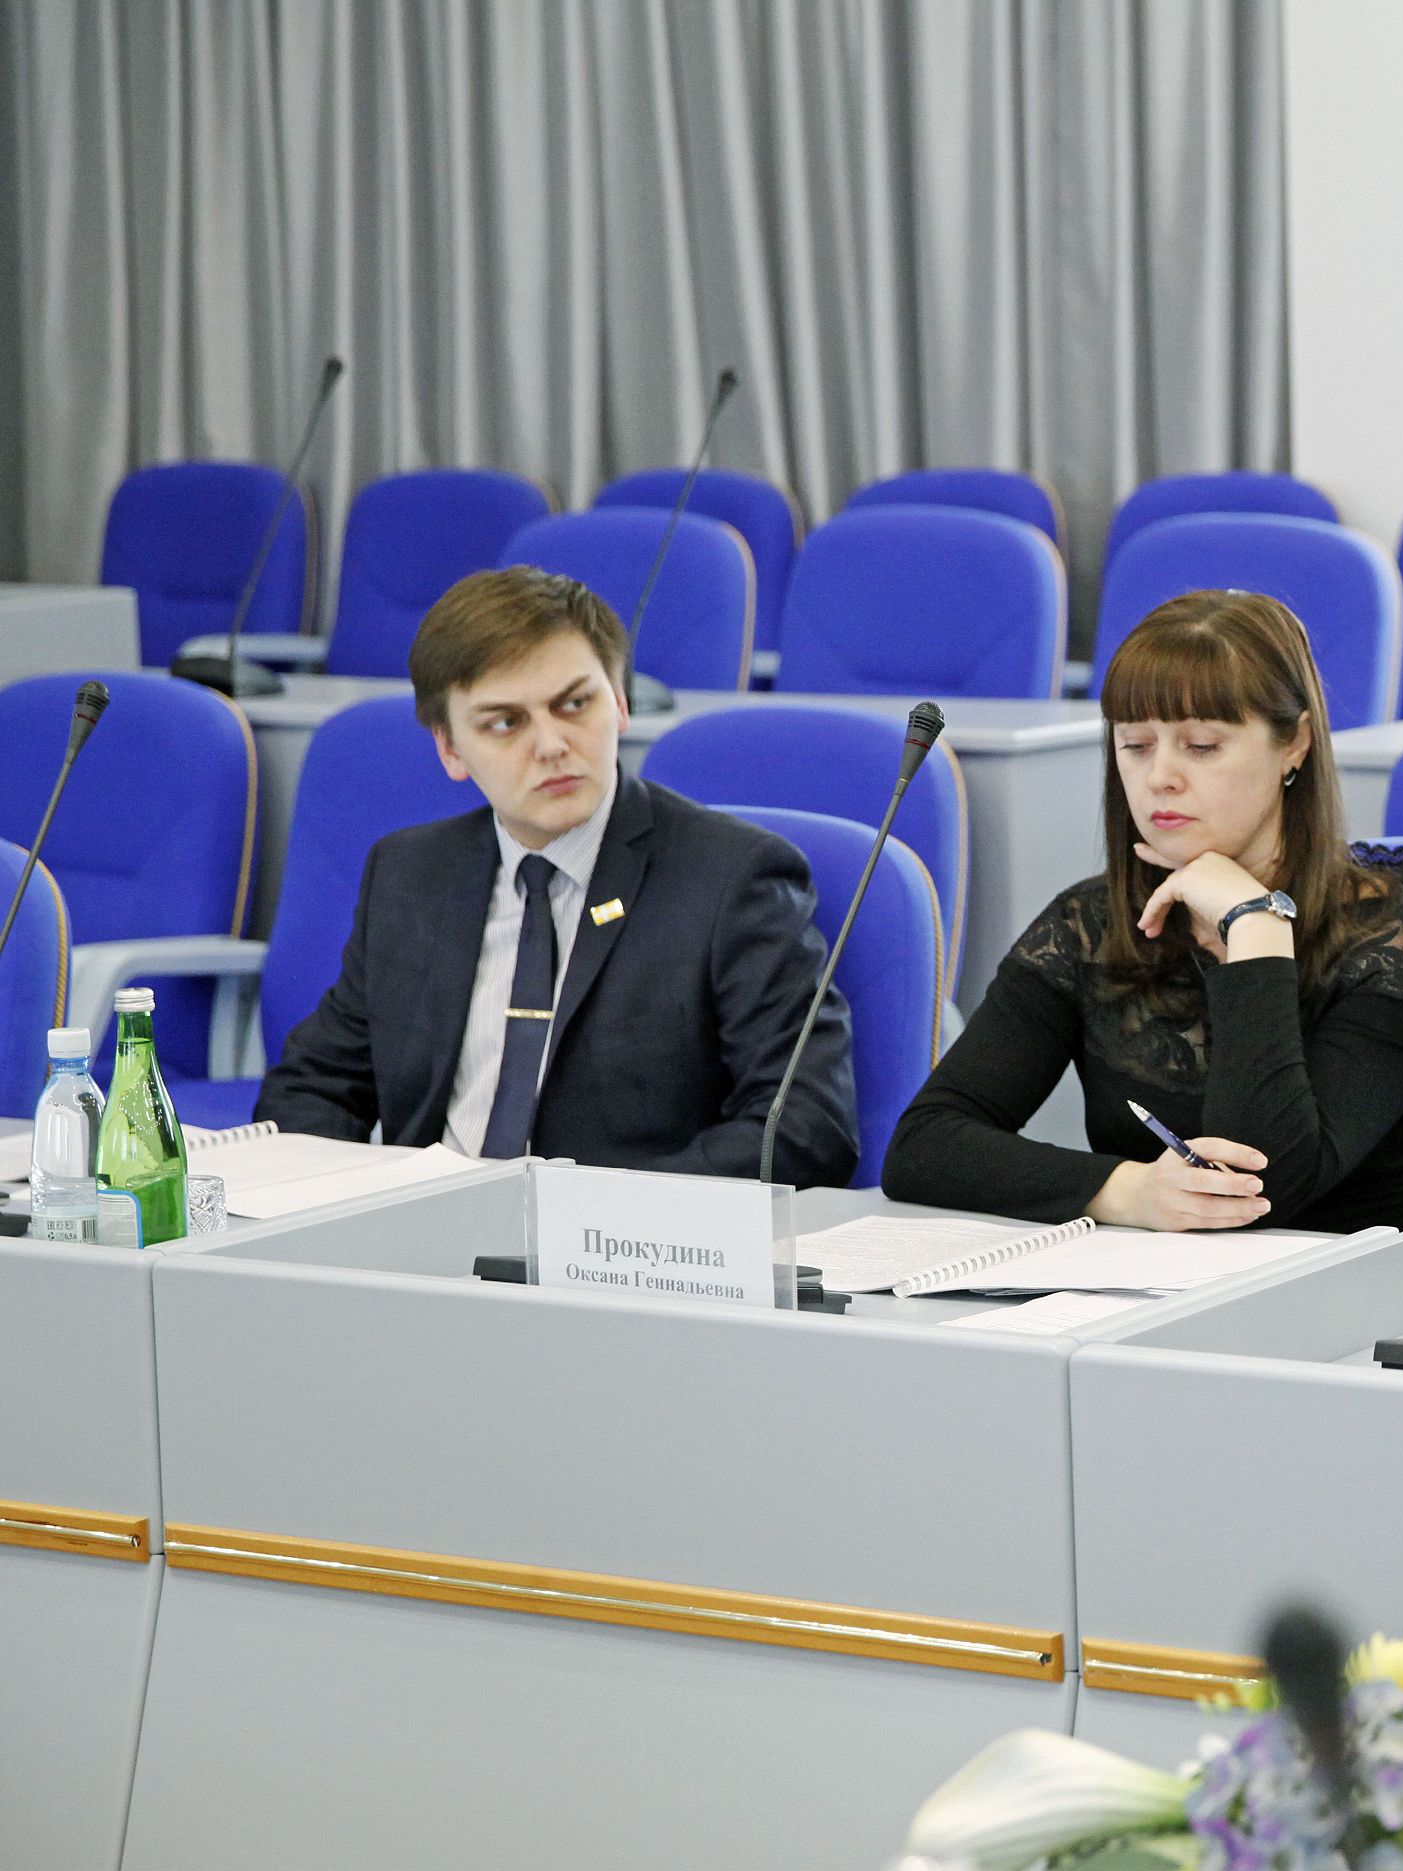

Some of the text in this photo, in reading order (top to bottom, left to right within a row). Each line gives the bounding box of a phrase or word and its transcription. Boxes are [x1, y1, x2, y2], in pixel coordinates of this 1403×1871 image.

[583, 1228, 726, 1268] Прокудина
[565, 1262, 745, 1300] Оксана Геннадьевна
